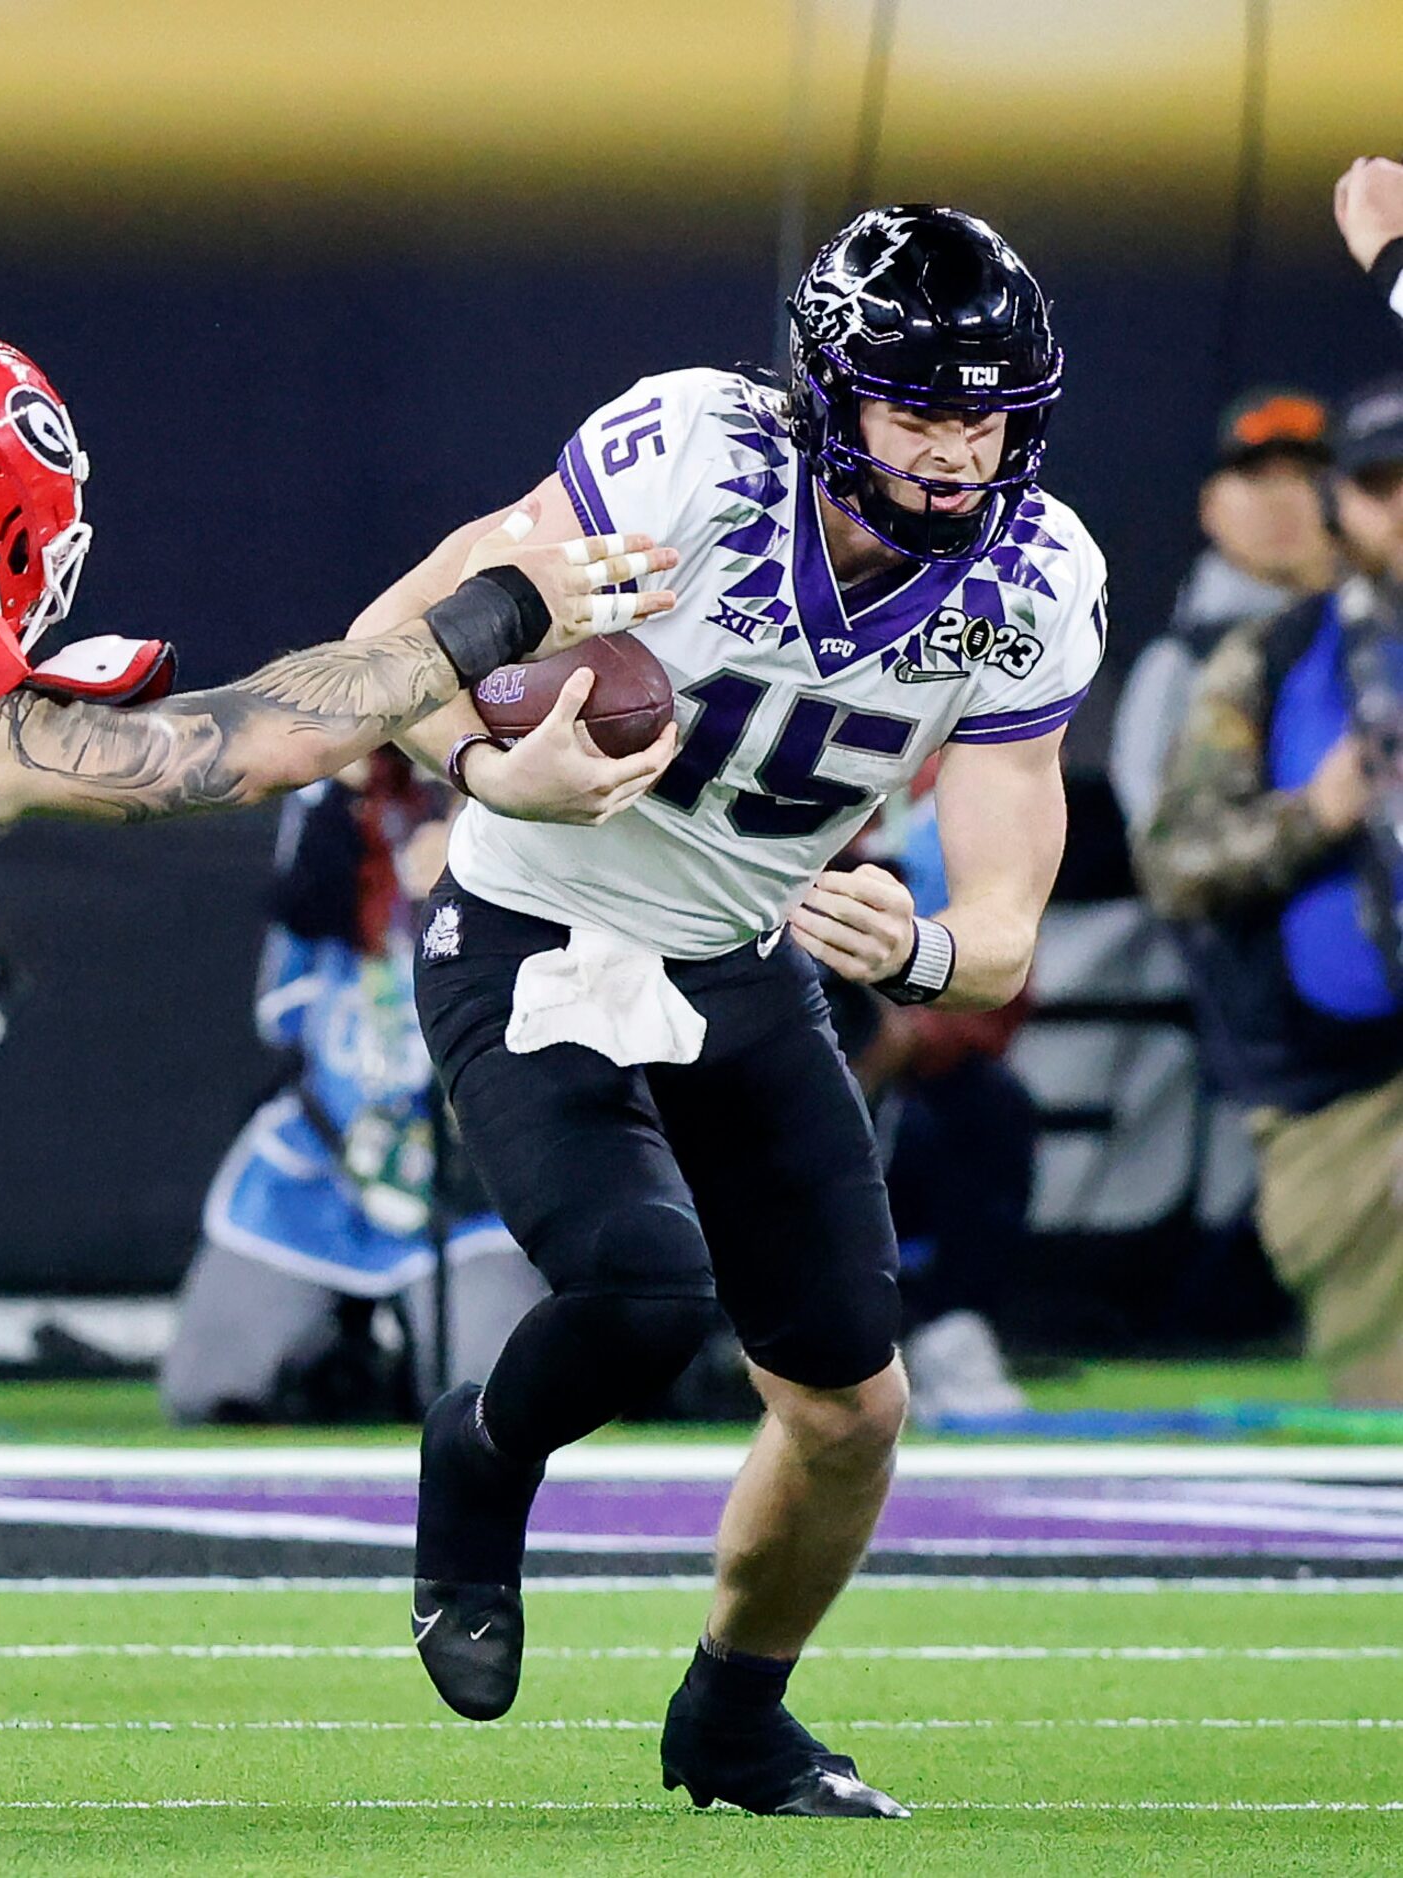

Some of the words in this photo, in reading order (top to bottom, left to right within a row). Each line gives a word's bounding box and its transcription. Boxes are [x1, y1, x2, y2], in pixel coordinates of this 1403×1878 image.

[958, 366, 999, 386] TCU
[601, 397, 665, 476] 15
[819, 638, 857, 658] TCU
[646, 667, 922, 839] 15
